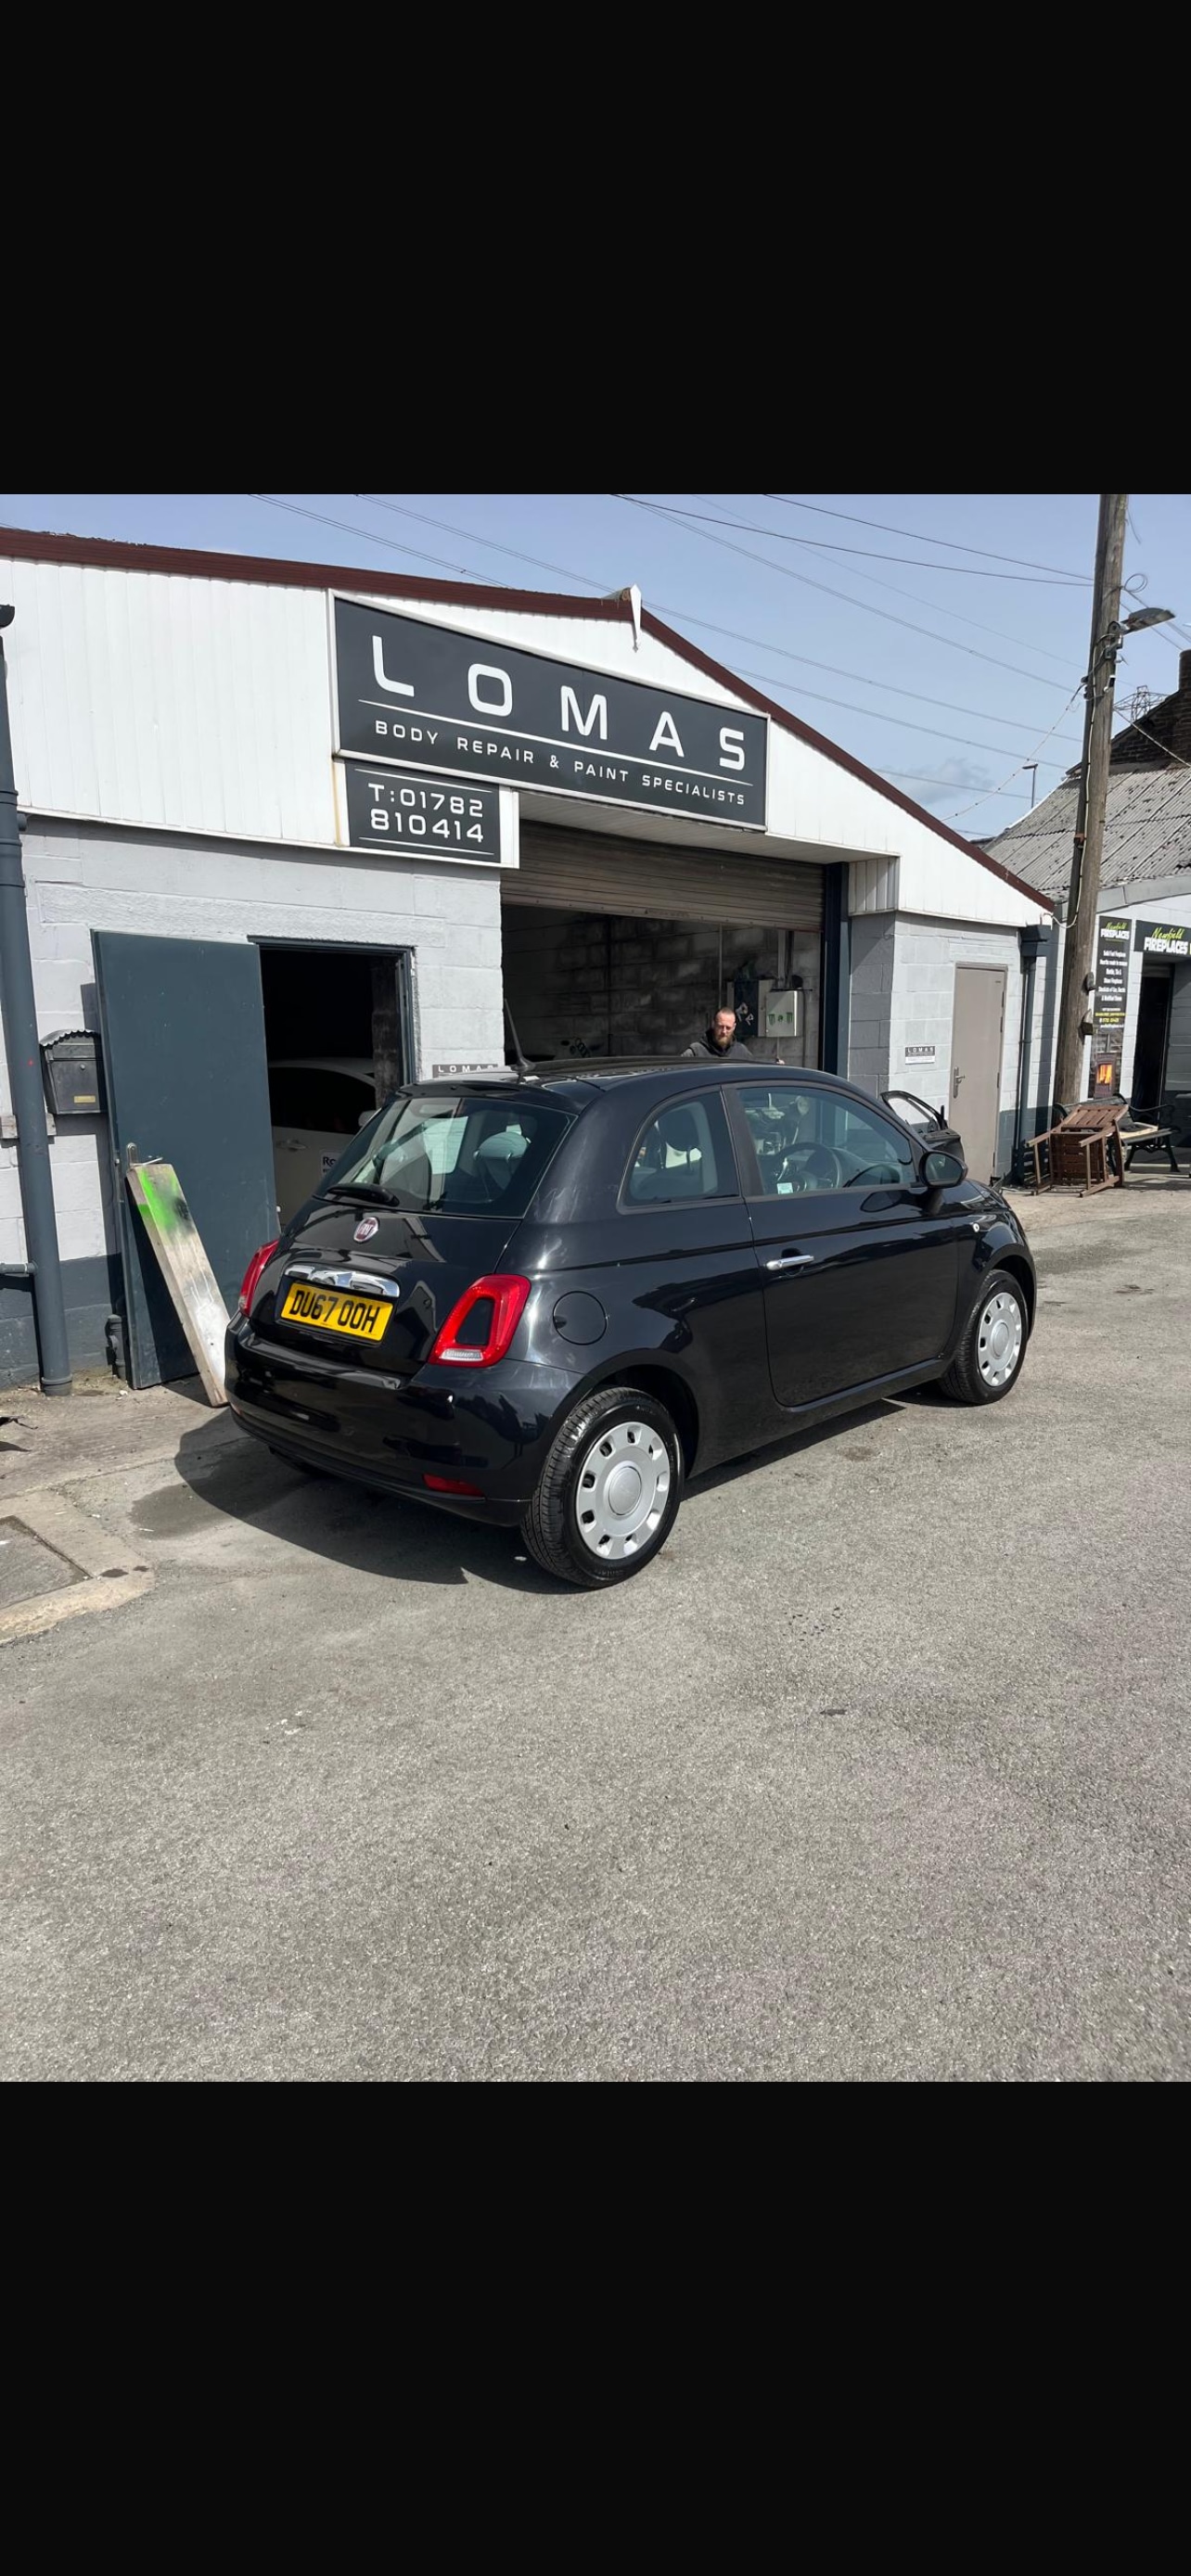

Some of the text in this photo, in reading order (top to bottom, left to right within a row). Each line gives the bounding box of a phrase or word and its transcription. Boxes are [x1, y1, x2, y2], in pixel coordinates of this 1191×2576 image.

[372, 635, 746, 771] LOMAS
[375, 720, 745, 805] BODY REPAIR & PAINT SPECIALISTS
[367, 783, 483, 818] T:01782
[370, 808, 484, 843] 810414
[1143, 937, 1189, 955] FIREPLACES
[1151, 926, 1185, 940] Newfield
[288, 1290, 380, 1333] DU67 OOH
